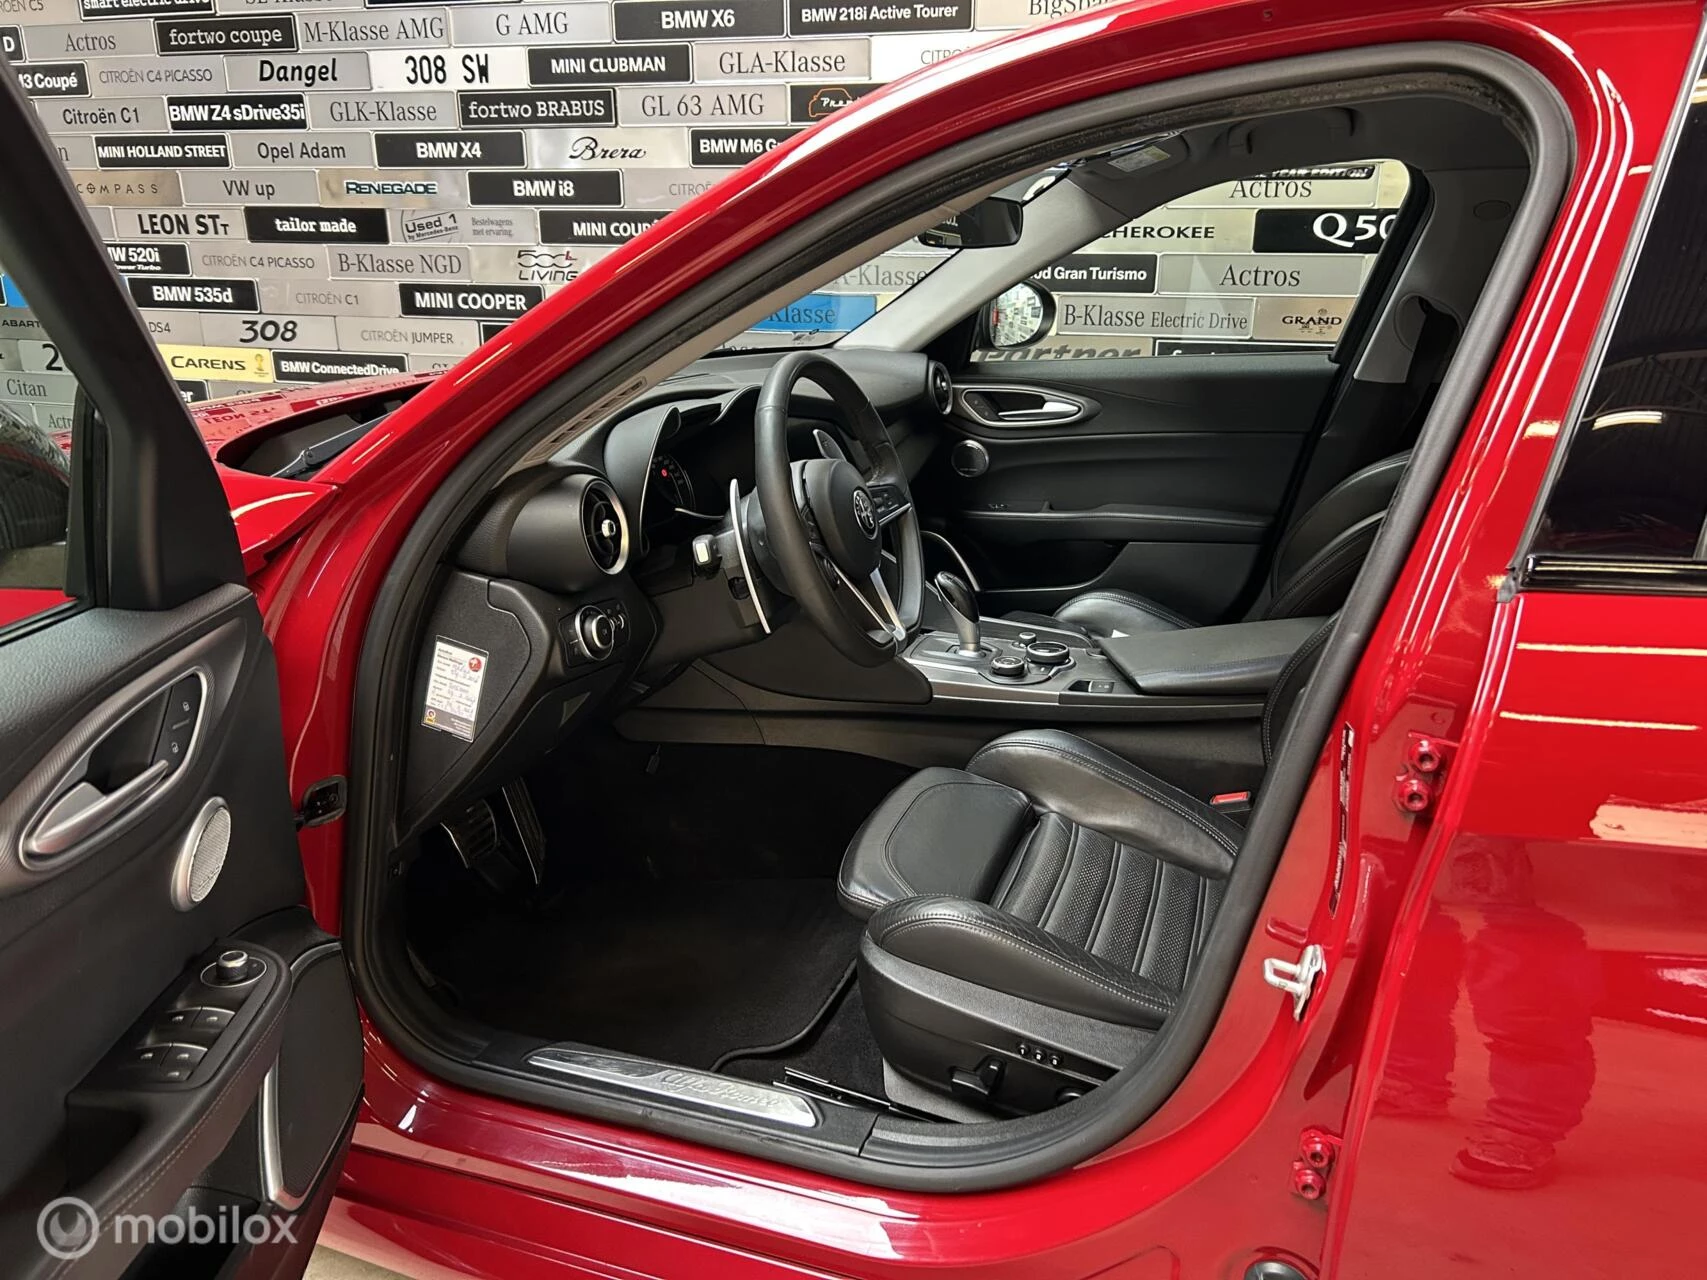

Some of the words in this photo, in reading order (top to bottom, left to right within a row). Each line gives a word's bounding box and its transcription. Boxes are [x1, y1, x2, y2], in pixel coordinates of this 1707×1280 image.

[84, 0, 119, 9] smart
[801, 7, 837, 23] BMW
[839, 6, 867, 21] 218i
[871, 5, 913, 20] Active
[916, 3, 958, 18] Tourer
[496, 14, 511, 36] G
[518, 12, 568, 35] AMG
[661, 10, 708, 29] BMW
[711, 9, 735, 28] X6
[169, 29, 226, 45] fortwo
[230, 28, 282, 45] coupe
[304, 22, 389, 42] M-Klasse
[397, 17, 444, 39] AMG
[65, 33, 116, 51] Actros
[405, 55, 447, 85] 308
[461, 53, 489, 84] SW
[551, 58, 585, 74] MINI
[589, 56, 666, 73] CLUBMAN
[719, 50, 846, 74] GLA-Klasse
[99, 69, 144, 84] CITROËN
[147, 69, 162, 83] C4
[164, 68, 213, 83] PICASSO
[259, 57, 338, 87] Dangel
[34, 72, 78, 91] Coupé
[170, 105, 209, 122] BMW
[211, 105, 231, 121] Z4
[234, 104, 305, 121] sDrive35i
[330, 102, 437, 122] GLK-Klasse
[468, 103, 531, 119] fortwo
[536, 101, 604, 117] BRABUS
[642, 95, 670, 117] GL
[677, 94, 702, 116] 63
[710, 93, 764, 116] AMG
[63, 109, 116, 125] Citroën
[121, 109, 140, 124] C1
[98, 145, 124, 159] MINI
[126, 144, 182, 158] HOLLAND
[185, 144, 226, 158] STREET
[257, 142, 294, 163] Opel
[300, 143, 346, 159] Adam
[416, 142, 458, 159] BMW
[460, 143, 482, 158] X4
[569, 136, 646, 161] Brera
[700, 138, 738, 153] BMW
[740, 138, 763, 153] M6
[223, 180, 249, 196] VW
[256, 182, 275, 199] up
[344, 180, 438, 195] RENEGADE
[513, 180, 556, 197] BMW
[559, 180, 575, 197] i8
[1229, 179, 1313, 198] Actros
[137, 213, 190, 235] LEON
[274, 217, 318, 234] tailor
[320, 217, 357, 233] made
[405, 216, 442, 233] Used
[448, 213, 457, 224] 1
[572, 222, 607, 237] MINI
[128, 247, 160, 262] 520i
[202, 253, 246, 267] CITROËN
[250, 256, 265, 268] C4
[268, 256, 315, 269] PICASSO
[339, 253, 414, 274] B-Klasse
[420, 254, 461, 274] NGD
[519, 270, 578, 282] LIVING
[1053, 266, 1087, 281] Gran
[1089, 266, 1148, 281] Turismo
[1219, 263, 1301, 287] Actros
[152, 285, 191, 302] BMW
[194, 286, 233, 303] 535d
[296, 290, 343, 305] CITROËN
[345, 294, 359, 305] C1
[415, 292, 453, 310] MINI
[457, 293, 527, 311] COOPER
[1063, 304, 1146, 328] B-Klasse
[1151, 311, 1204, 329] Electric
[1209, 312, 1248, 330] Drive
[1281, 315, 1342, 326] GRAND
[239, 319, 297, 344] 308
[361, 326, 408, 343] CITROËN
[411, 332, 453, 345] JUMPER
[171, 355, 246, 371] CARENS
[281, 360, 310, 374] BMW
[312, 361, 399, 377] ConnectedDrive
[6, 378, 48, 397] Citan
